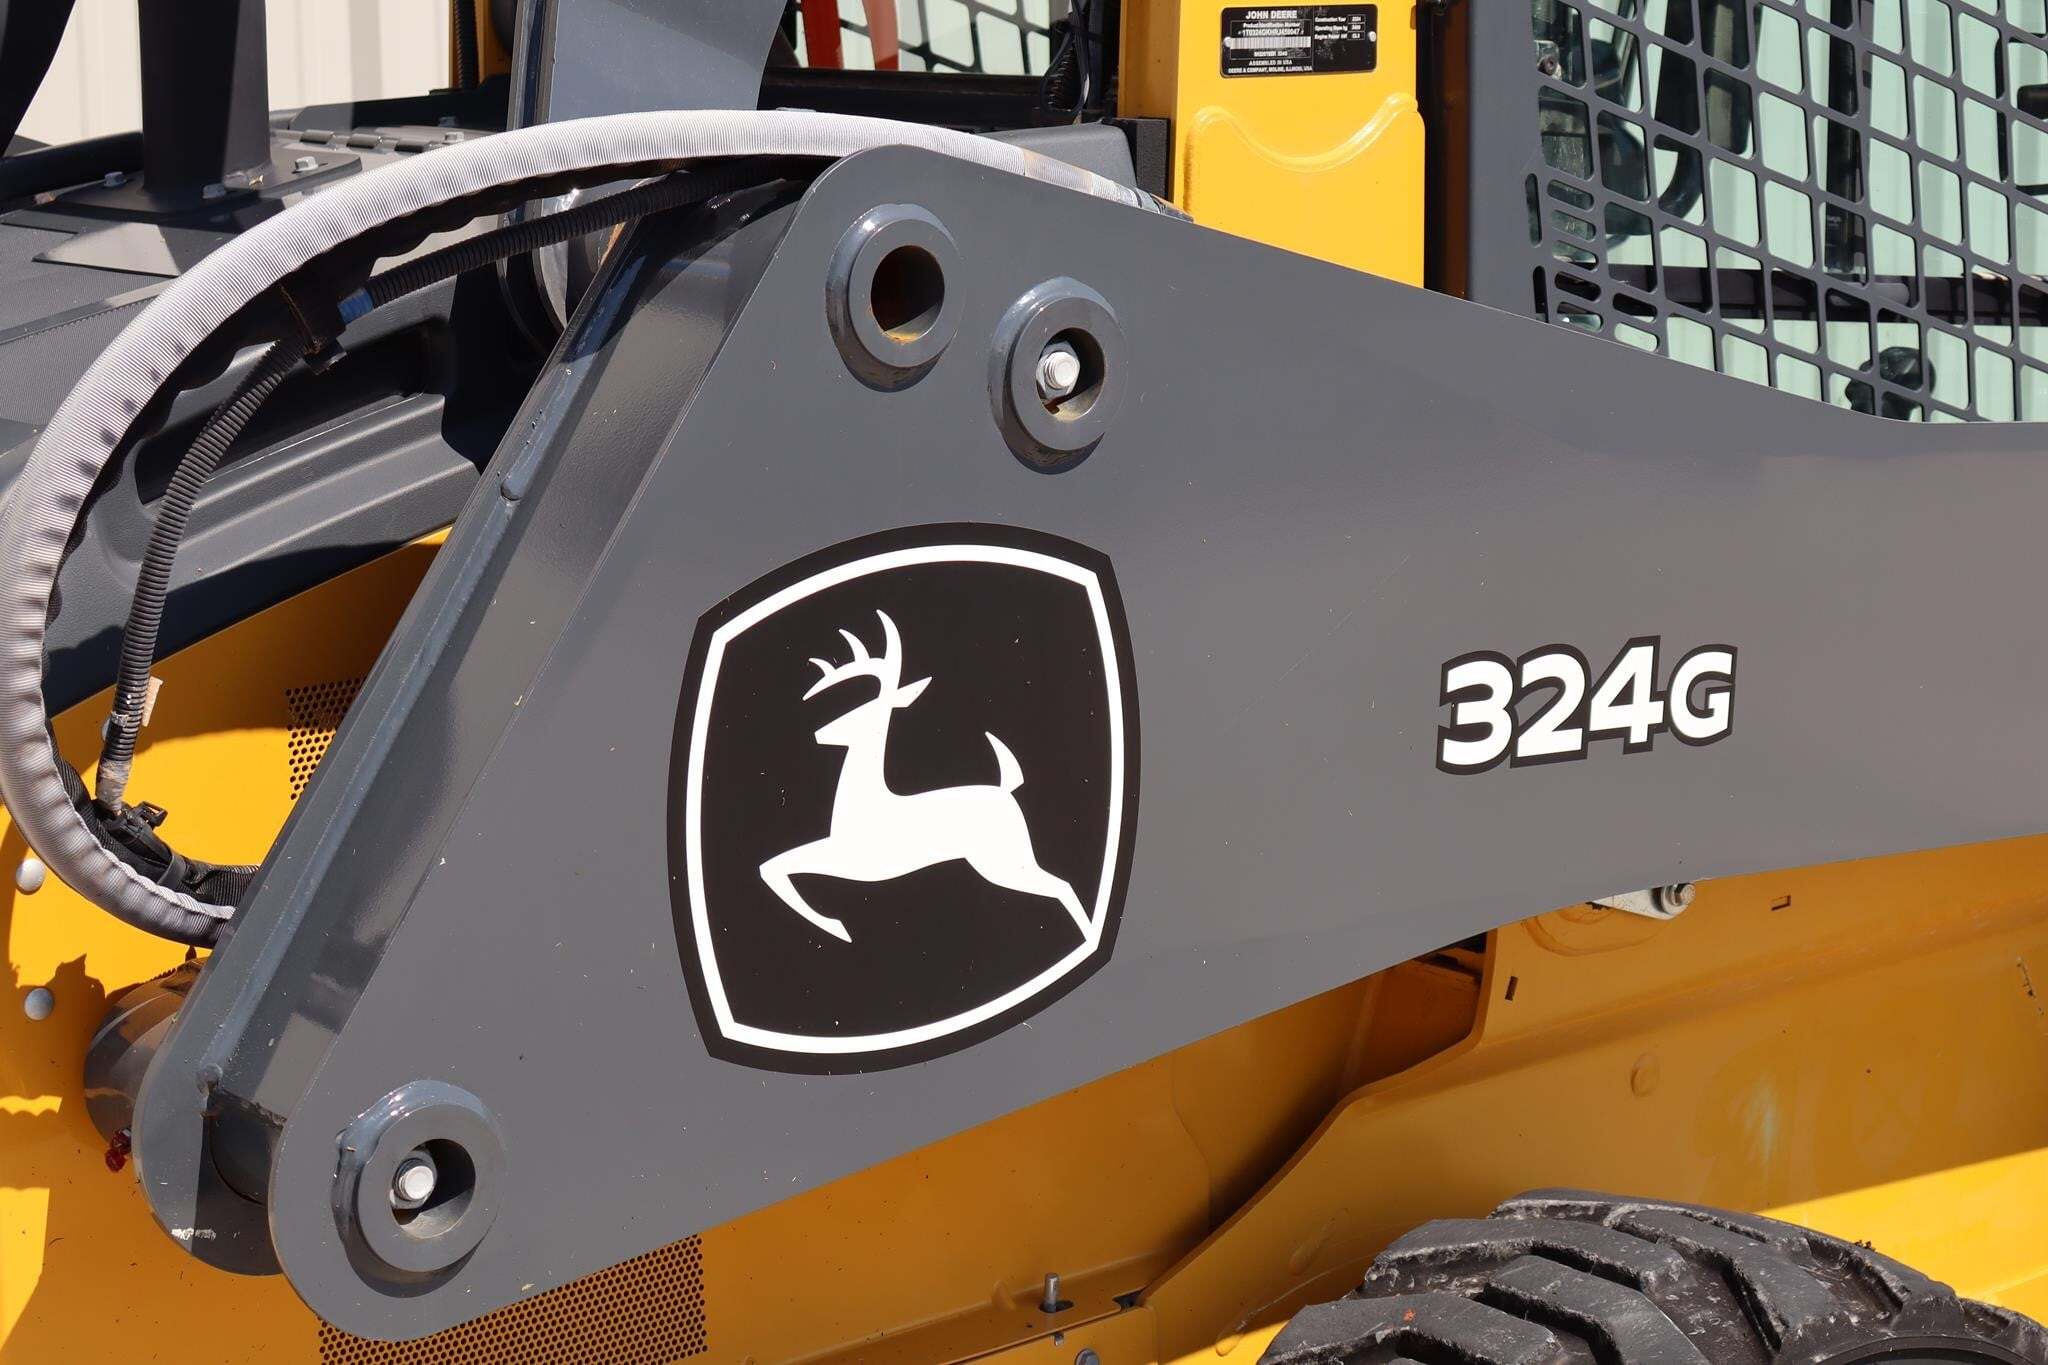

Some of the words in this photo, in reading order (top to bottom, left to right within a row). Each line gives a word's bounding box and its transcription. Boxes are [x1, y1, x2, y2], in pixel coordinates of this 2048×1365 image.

[1246, 11, 1268, 19] JOHN
[1271, 10, 1297, 19] DEERE
[1437, 636, 1736, 774] 324G
